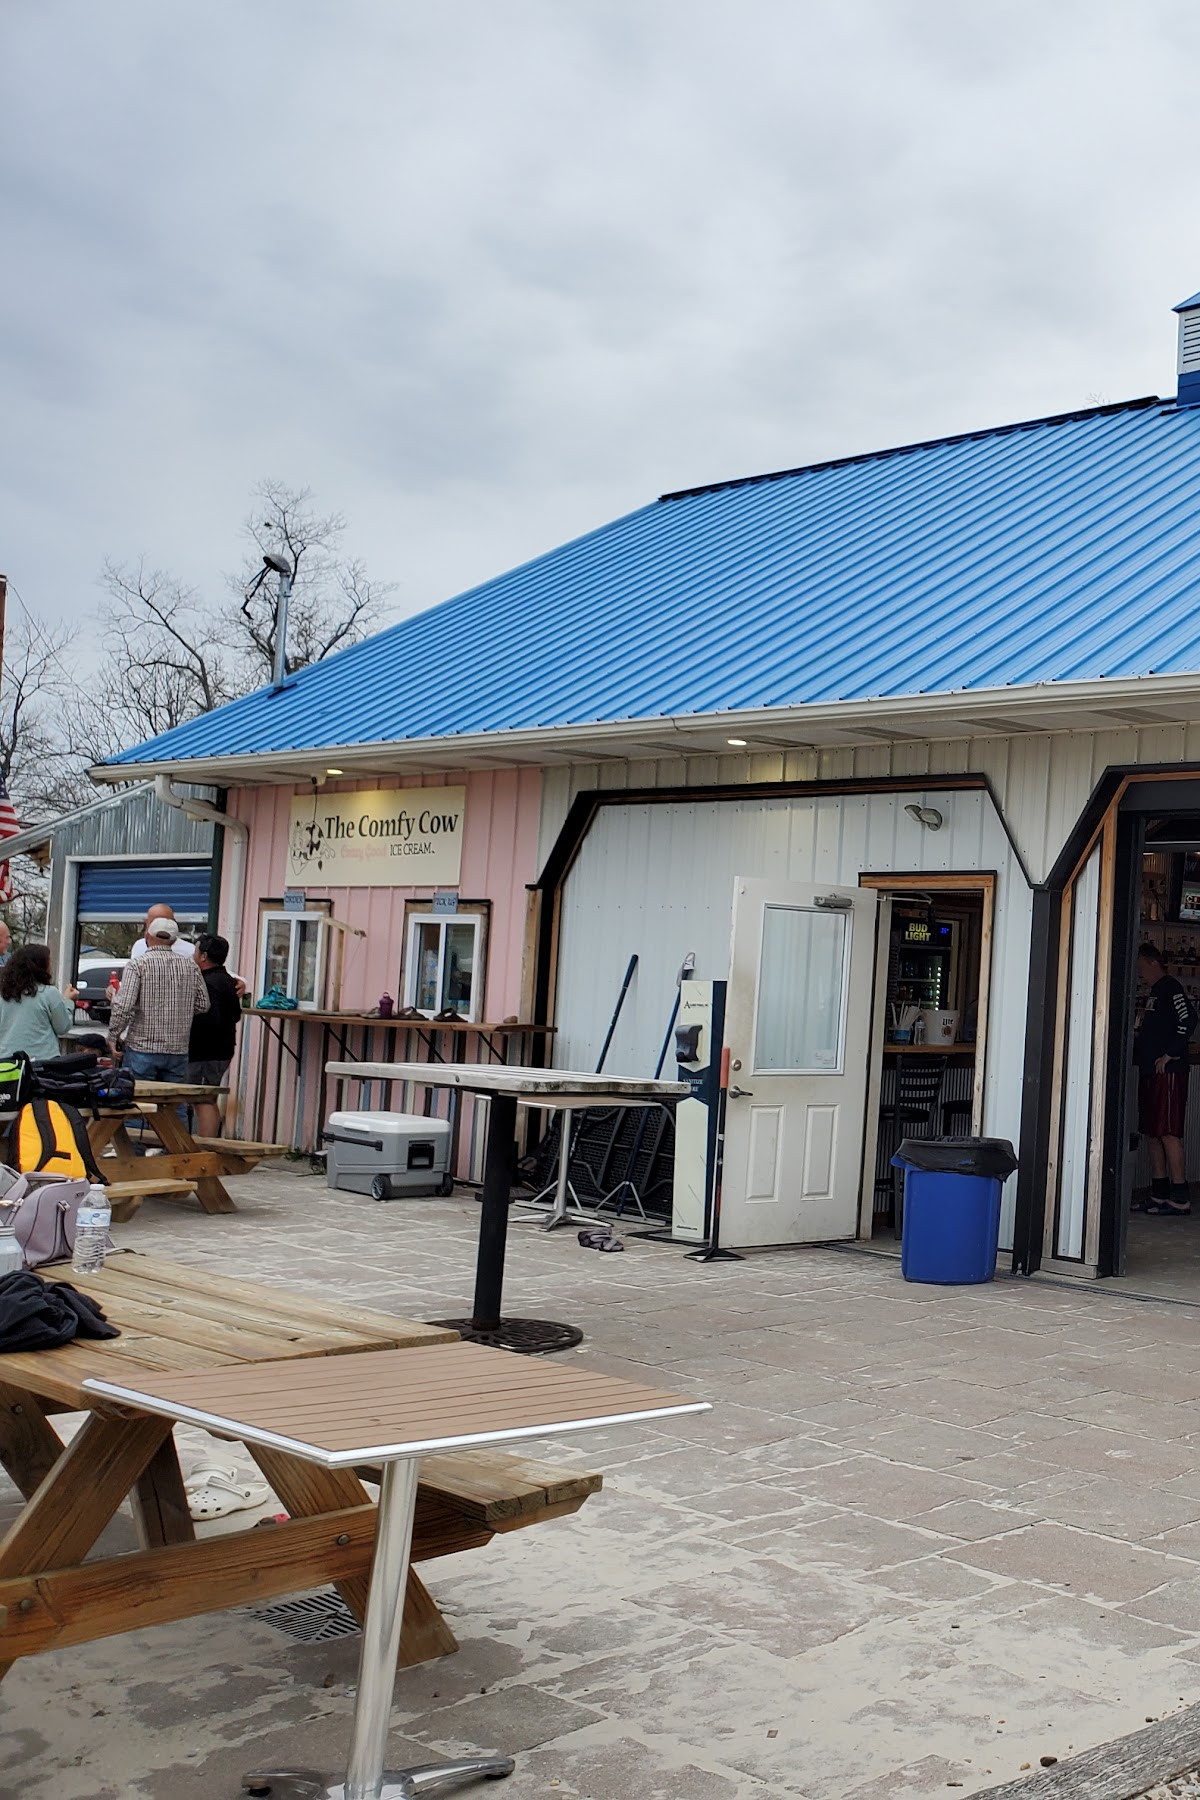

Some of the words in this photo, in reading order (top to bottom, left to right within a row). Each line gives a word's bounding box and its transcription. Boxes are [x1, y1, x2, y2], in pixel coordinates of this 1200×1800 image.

[325, 814, 355, 839] The
[358, 810, 415, 841] Comfy
[418, 810, 459, 834] Cow
[390, 843, 402, 856] ICE
[908, 923, 928, 932] BUD
[905, 931, 931, 942] LIGHT
